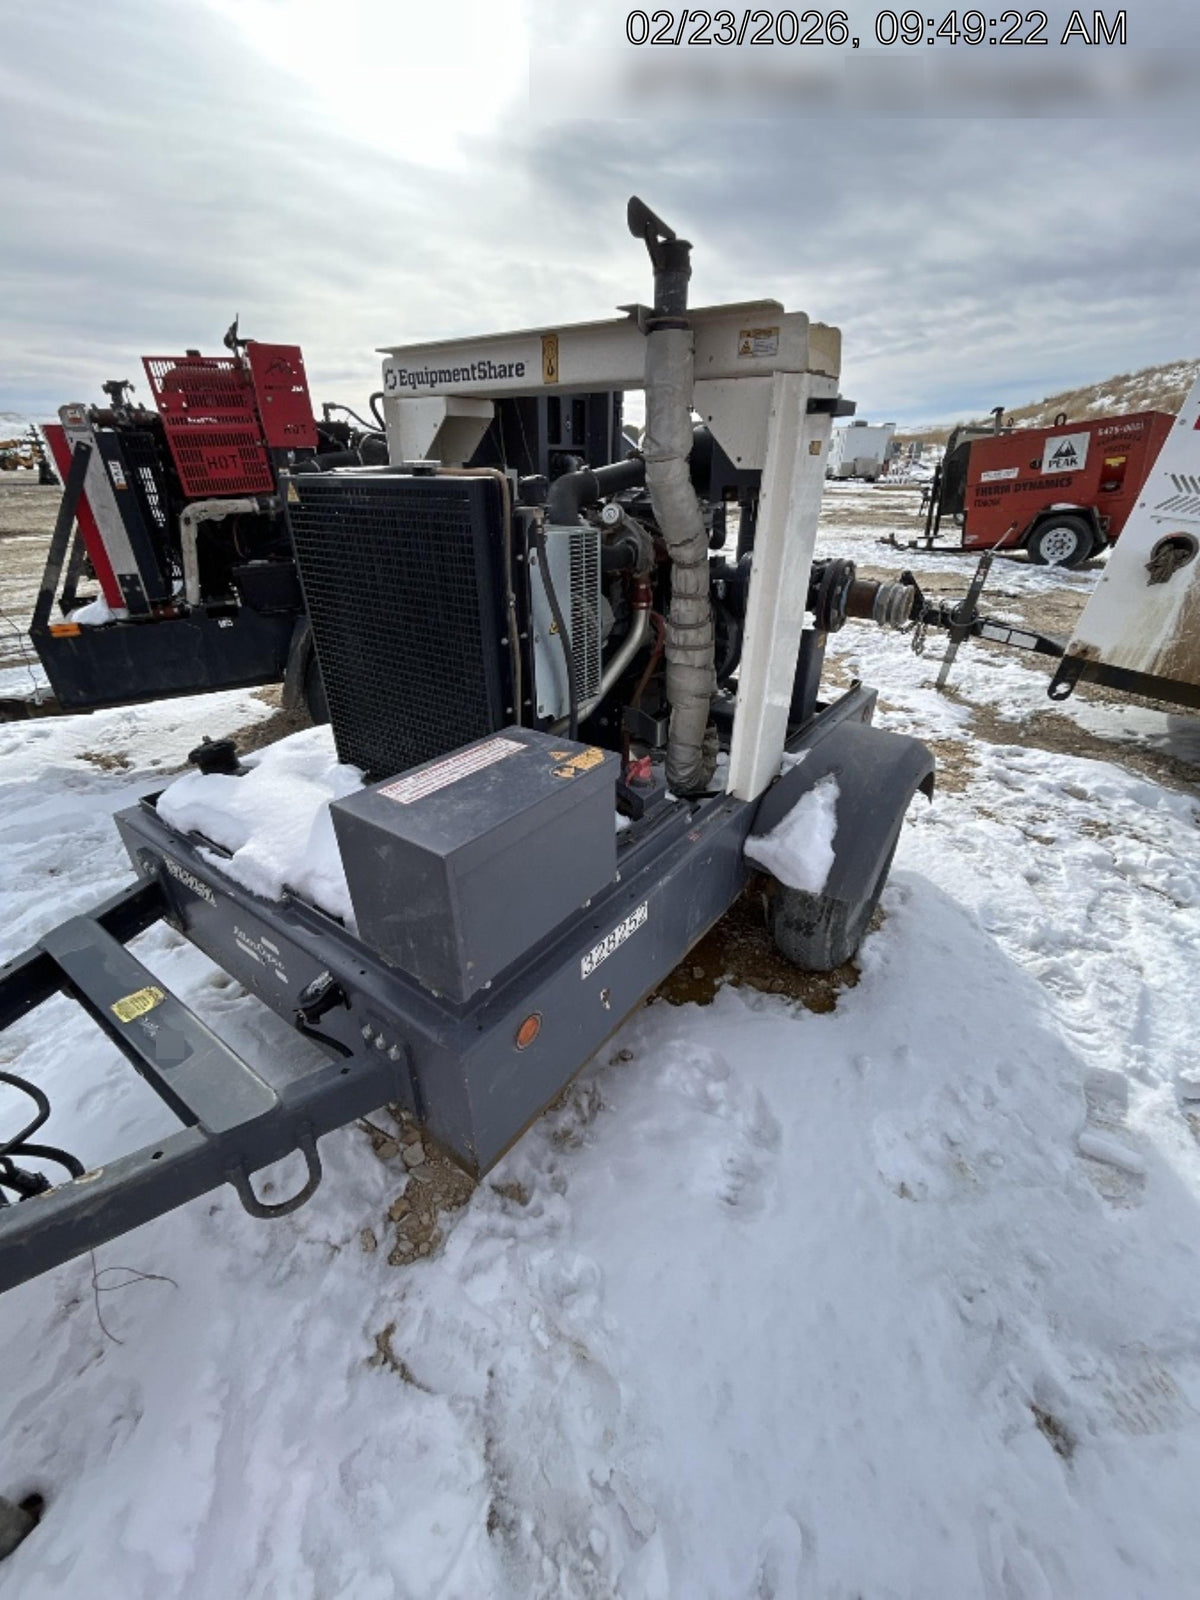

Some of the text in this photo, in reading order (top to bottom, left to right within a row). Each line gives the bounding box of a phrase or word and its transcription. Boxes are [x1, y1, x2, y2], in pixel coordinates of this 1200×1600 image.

[400, 361, 525, 389] EquipmentShare
[207, 454, 239, 470] HOT
[1048, 456, 1078, 468] PEAK
[1014, 477, 1073, 493] DYNAMICS
